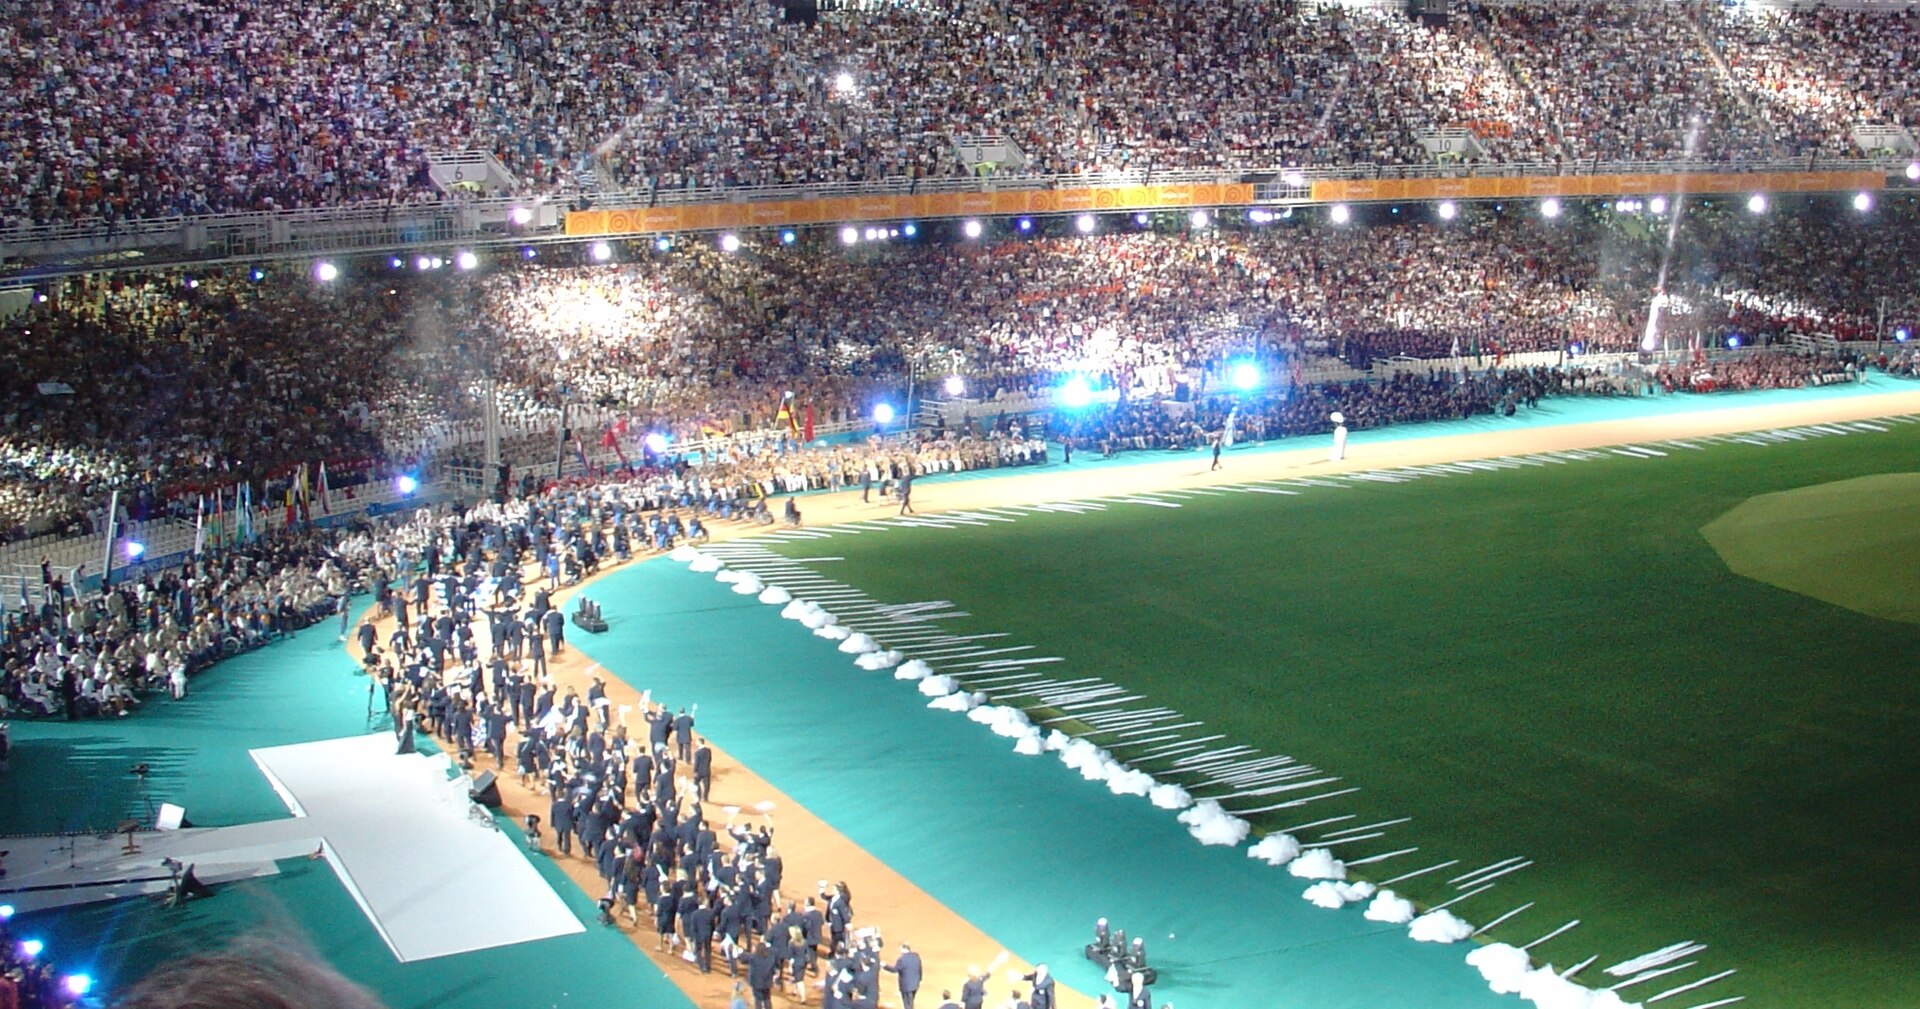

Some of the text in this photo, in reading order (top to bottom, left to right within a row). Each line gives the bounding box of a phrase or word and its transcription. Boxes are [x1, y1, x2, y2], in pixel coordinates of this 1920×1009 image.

[1439, 139, 1451, 151] 10
[976, 147, 983, 161] 8
[455, 166, 463, 180] 6
